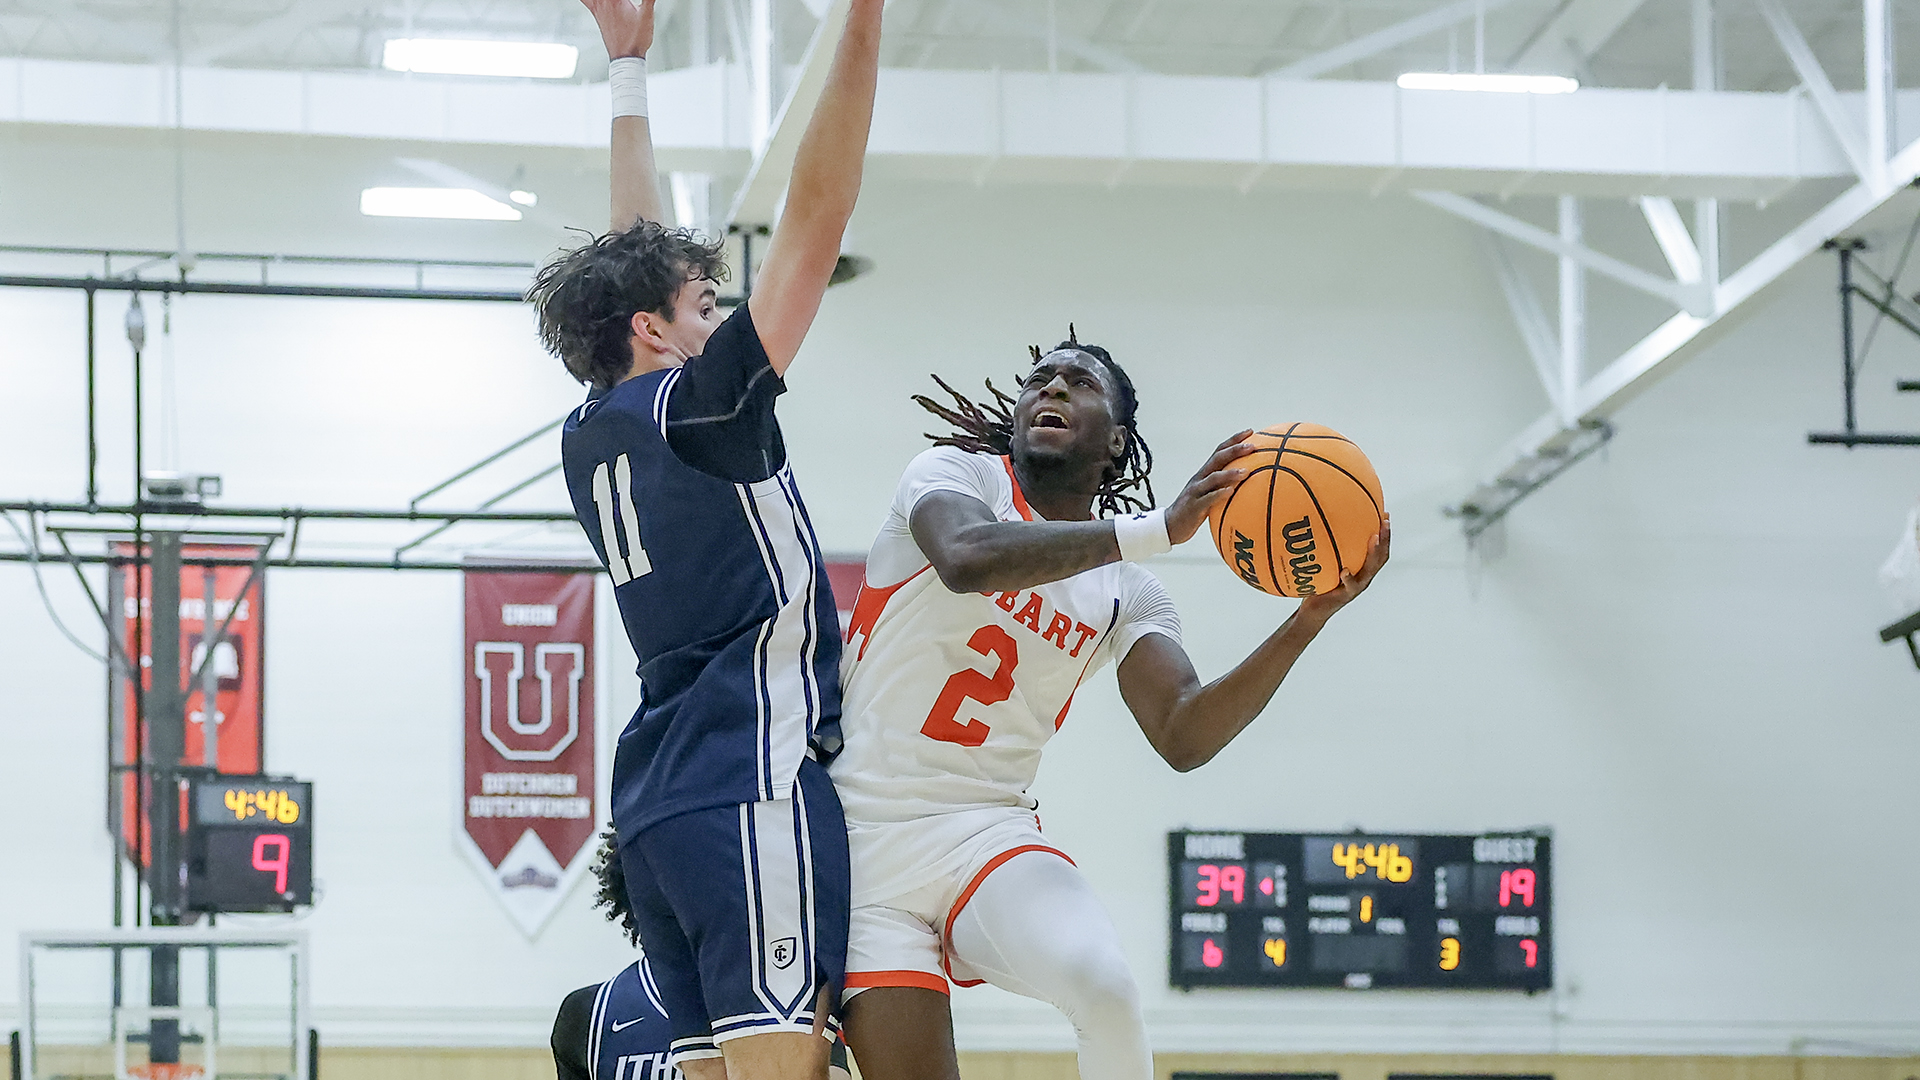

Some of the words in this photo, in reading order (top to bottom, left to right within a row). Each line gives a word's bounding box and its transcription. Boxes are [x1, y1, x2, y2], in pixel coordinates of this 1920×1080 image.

[592, 453, 653, 587] 11
[979, 589, 1098, 658] BART
[475, 641, 584, 761] U
[920, 624, 1019, 747] 2
[224, 789, 299, 824] 4:46
[252, 834, 290, 894] 9
[1332, 842, 1413, 883] 4:46
[1197, 865, 1246, 907] 39
[1499, 869, 1536, 907] 19
[1359, 895, 1373, 923] 1
[1202, 938, 1223, 968] 6
[1264, 938, 1286, 967] 4
[1439, 937, 1460, 971] 3
[1519, 939, 1537, 968] 7
